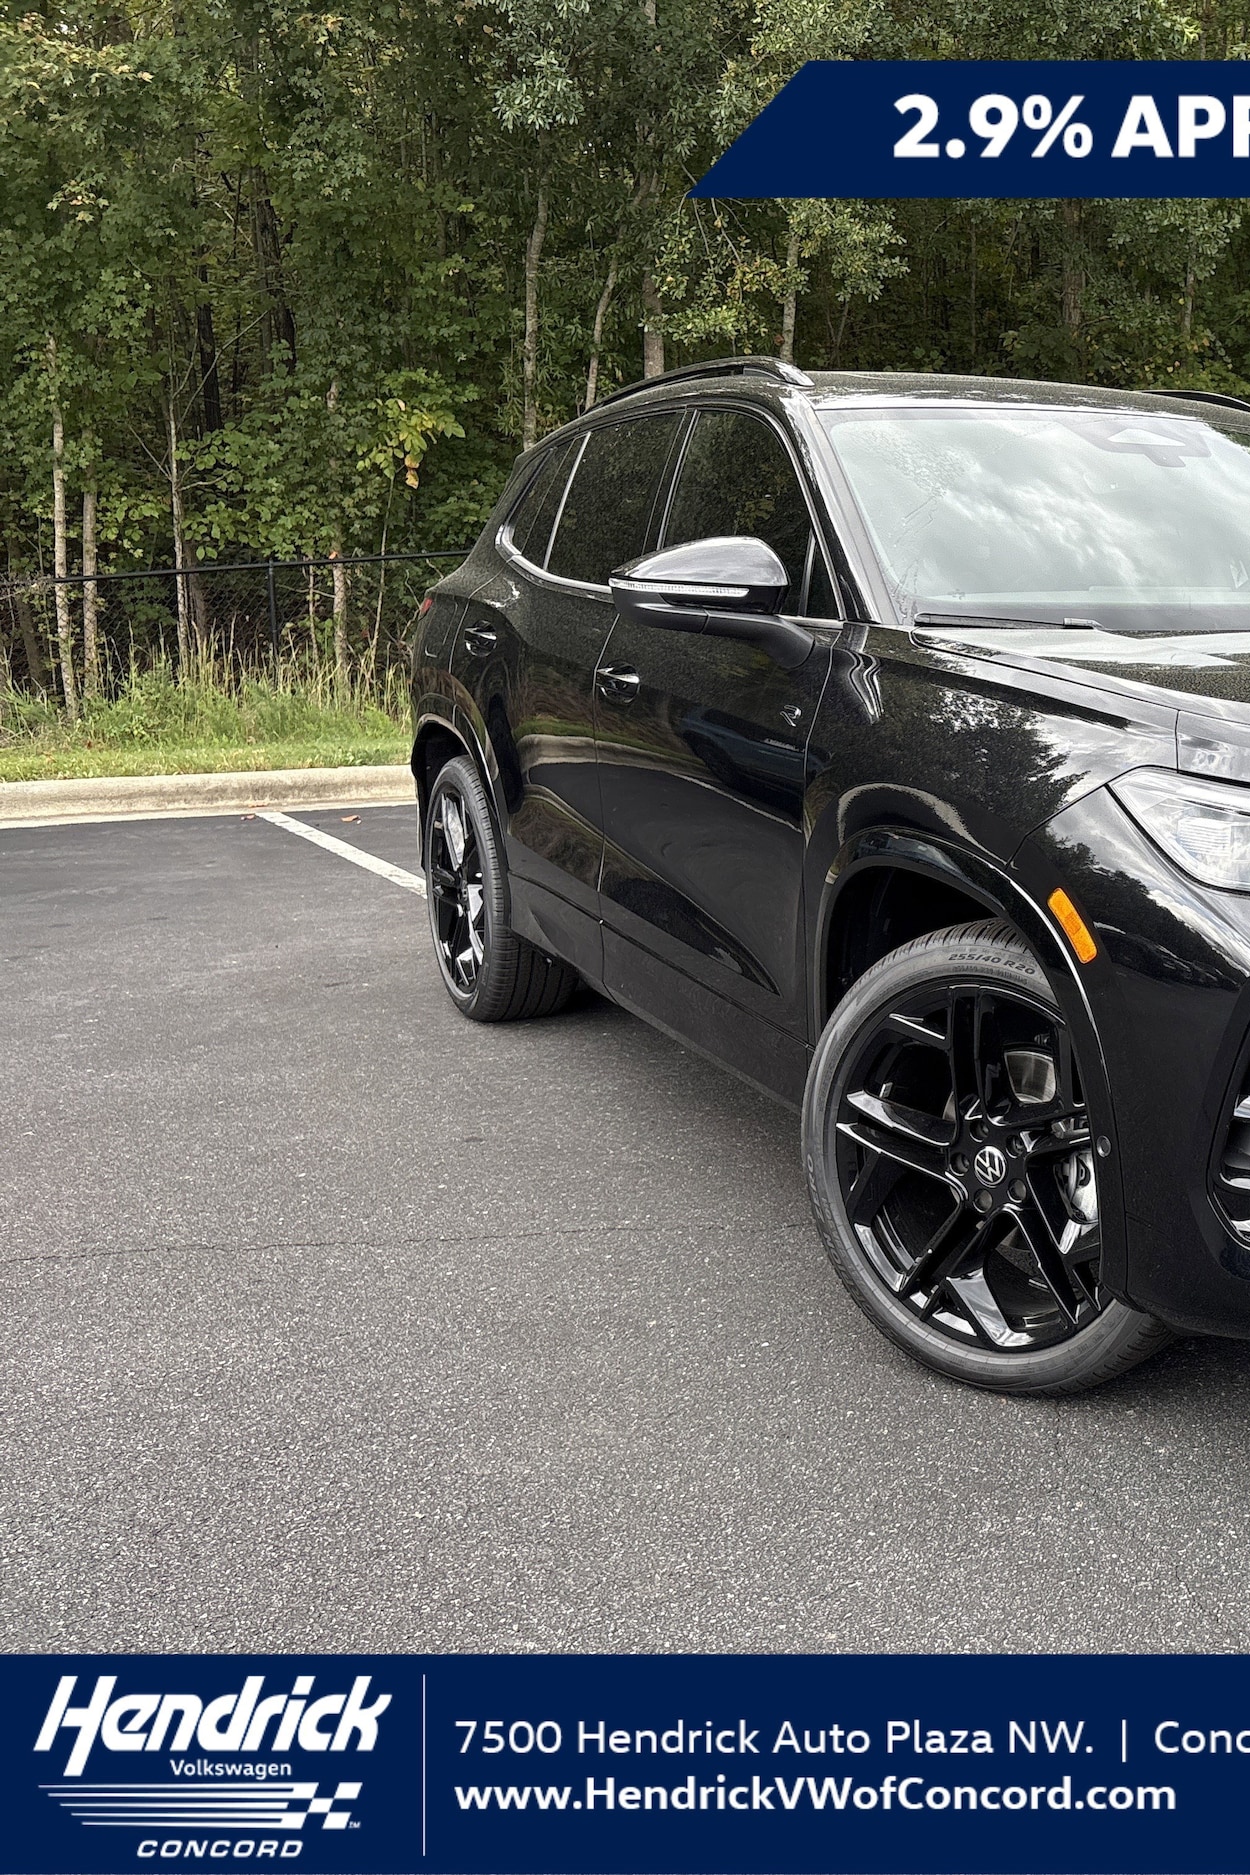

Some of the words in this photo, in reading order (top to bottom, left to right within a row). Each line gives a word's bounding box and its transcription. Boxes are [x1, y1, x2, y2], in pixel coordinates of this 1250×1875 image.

[948, 953, 1002, 964] 255/40
[1003, 960, 1036, 975] R20
[974, 1146, 1006, 1186] VW
